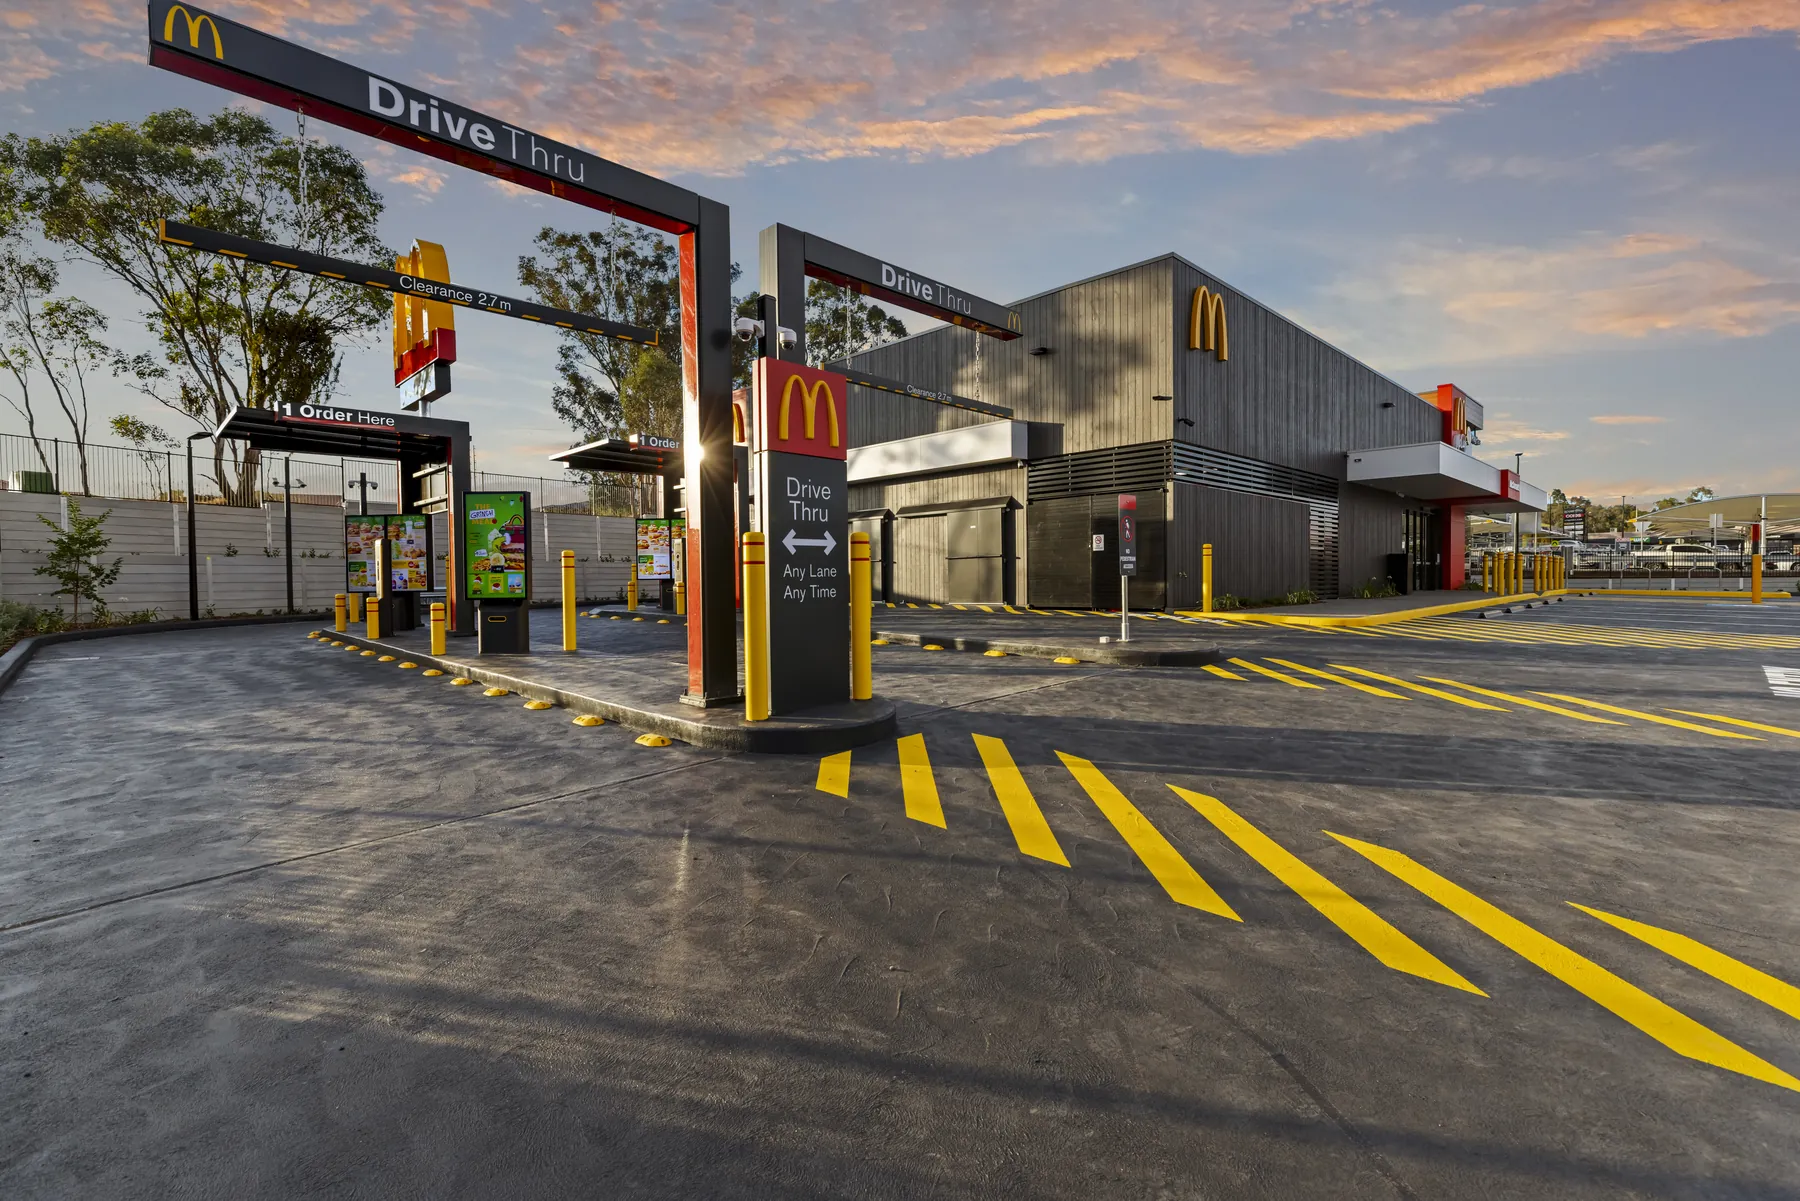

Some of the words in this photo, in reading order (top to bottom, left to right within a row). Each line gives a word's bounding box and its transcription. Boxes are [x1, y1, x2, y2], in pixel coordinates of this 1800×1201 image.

[368, 75, 496, 151] Drive
[501, 124, 584, 183] Thru
[399, 275, 473, 303] Clearance
[881, 263, 933, 301] Drive
[935, 283, 971, 315] Thru
[906, 384, 937, 399] Clearance
[282, 402, 292, 416] 1
[300, 404, 353, 422] Order
[358, 411, 395, 427] Here
[649, 436, 680, 449] Order
[786, 476, 832, 500] Drive
[788, 500, 829, 522] Thru
[783, 563, 806, 581] Any
[809, 563, 837, 578] Lane
[783, 585, 806, 603] Any
[809, 584, 837, 599] Time
